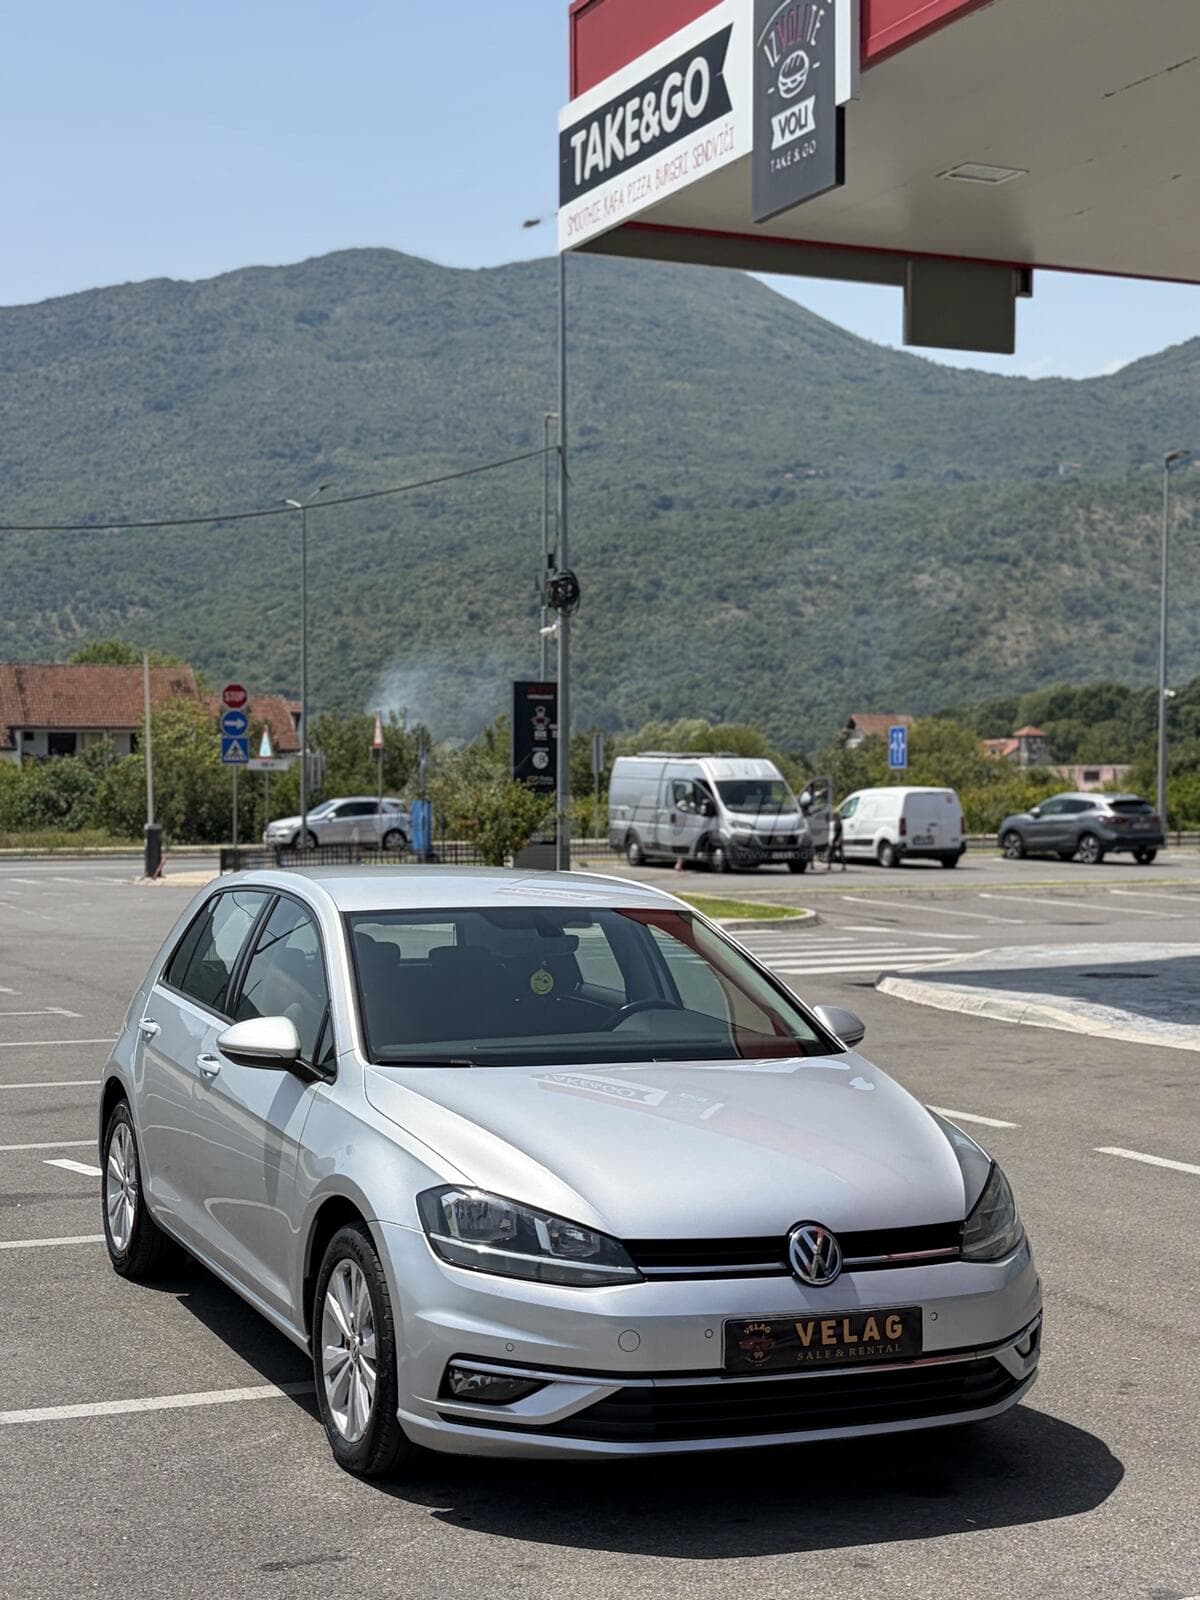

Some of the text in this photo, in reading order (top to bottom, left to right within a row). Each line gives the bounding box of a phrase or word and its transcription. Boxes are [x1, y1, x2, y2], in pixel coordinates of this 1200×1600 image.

[570, 56, 710, 186] TAKE&GO
[778, 104, 808, 140] VOLI
[769, 140, 816, 173] TAKE & GO
[567, 201, 601, 237] SMOOTHIE
[602, 189, 624, 216] KAFA
[627, 174, 652, 206] PIZZA
[654, 151, 689, 190] BURGERI
[224, 691, 245, 702] STOP
[743, 1323, 771, 1334] VELAG
[795, 1314, 903, 1347] VELAG
[797, 1343, 901, 1361] SALE & RENTAL
